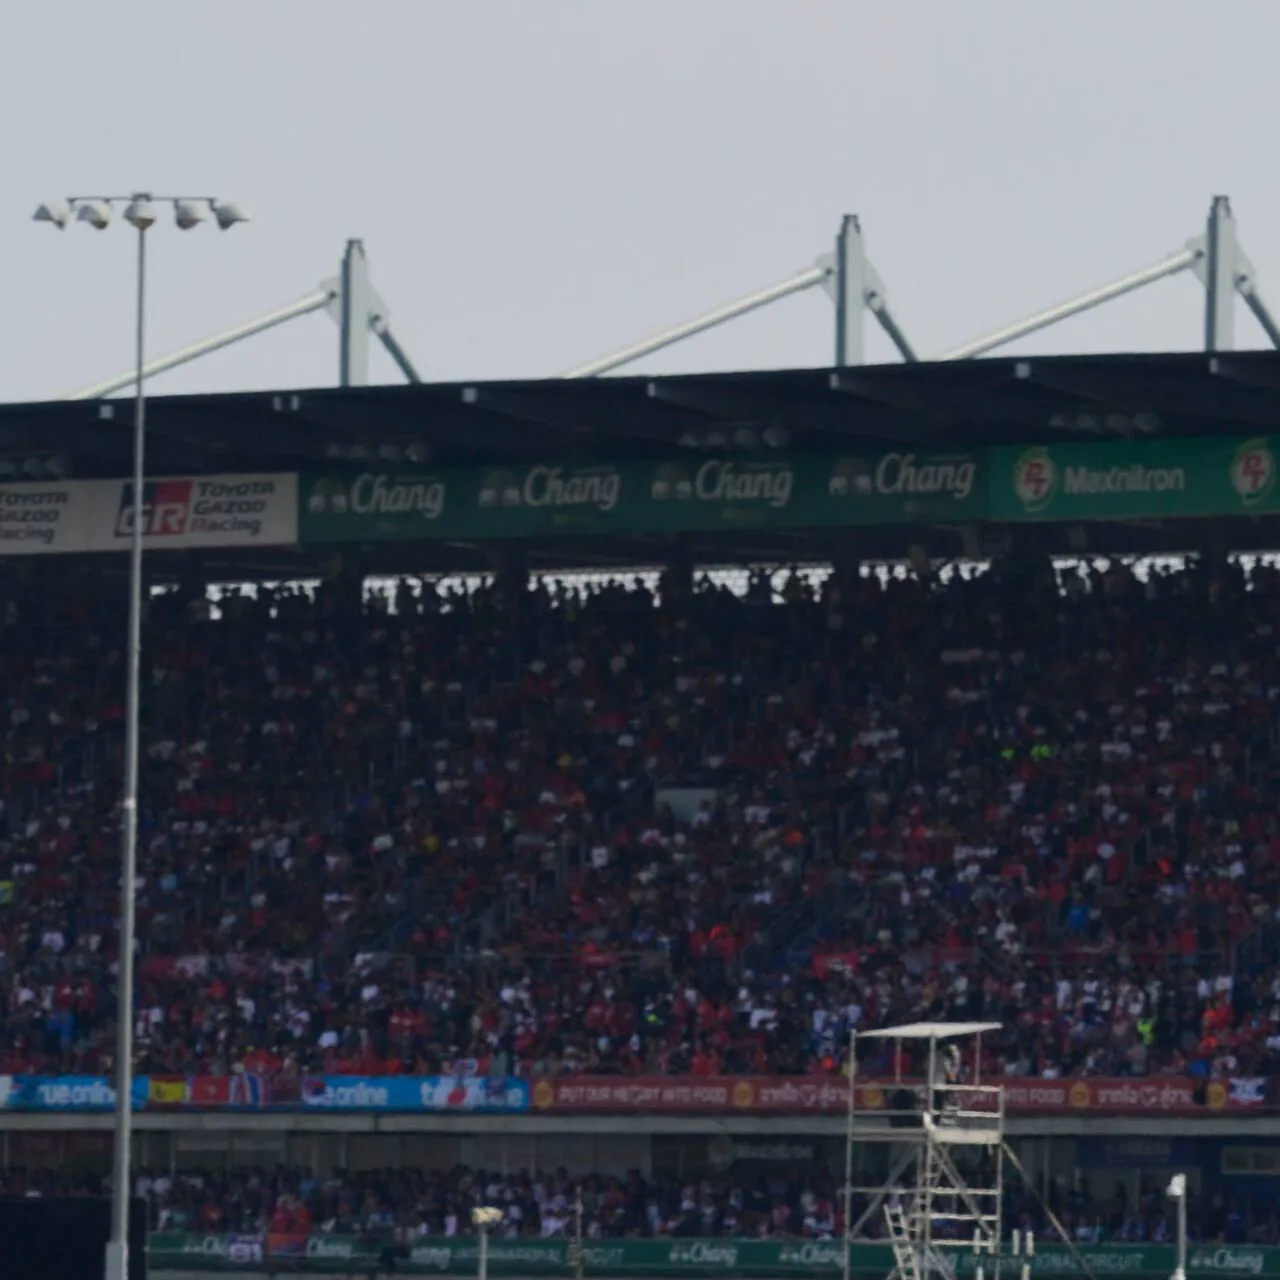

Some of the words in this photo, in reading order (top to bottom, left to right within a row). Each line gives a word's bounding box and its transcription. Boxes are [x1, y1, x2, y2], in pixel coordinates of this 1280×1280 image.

[350, 472, 446, 519] Chang
[523, 466, 620, 511] Chang
[695, 460, 793, 508] Chang
[875, 453, 976, 500] Chang
[116, 503, 185, 535] GR
[689, 1241, 738, 1268] Chang
[1214, 1249, 1263, 1275] Chang
